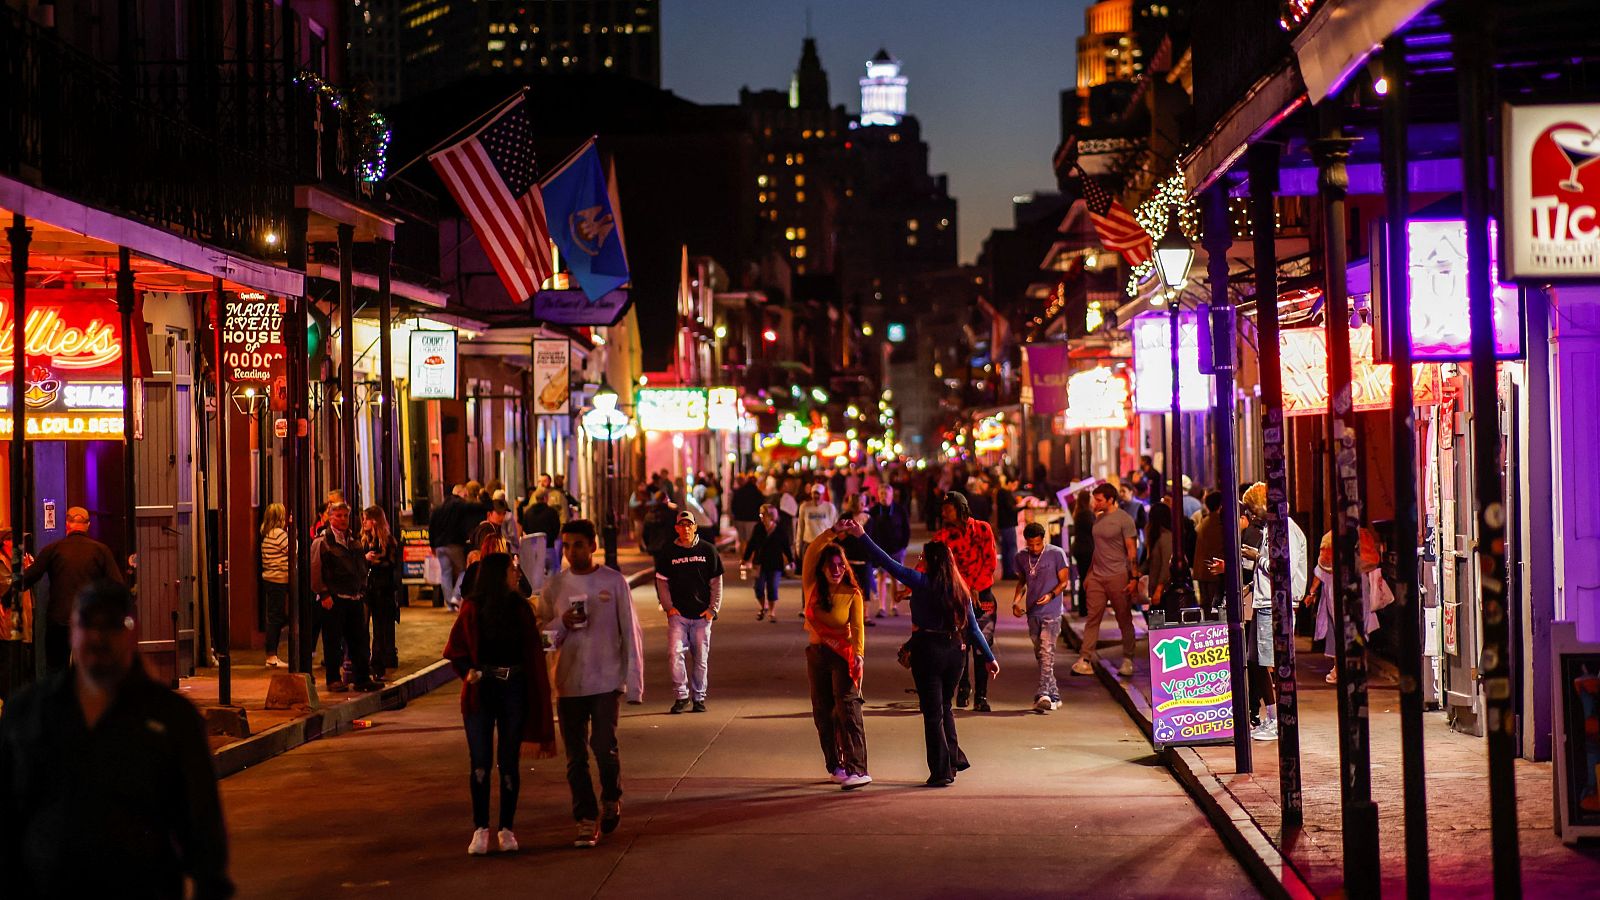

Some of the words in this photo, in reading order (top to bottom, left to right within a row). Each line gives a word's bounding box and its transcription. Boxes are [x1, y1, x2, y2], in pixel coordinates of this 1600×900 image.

[226, 303, 280, 317] MARIE
[209, 316, 283, 330] AVEAU
[223, 331, 281, 344] HOUSE
[234, 368, 270, 380] Readings
[42, 417, 84, 434] COLD
[1181, 718, 1233, 737] GIFTS
